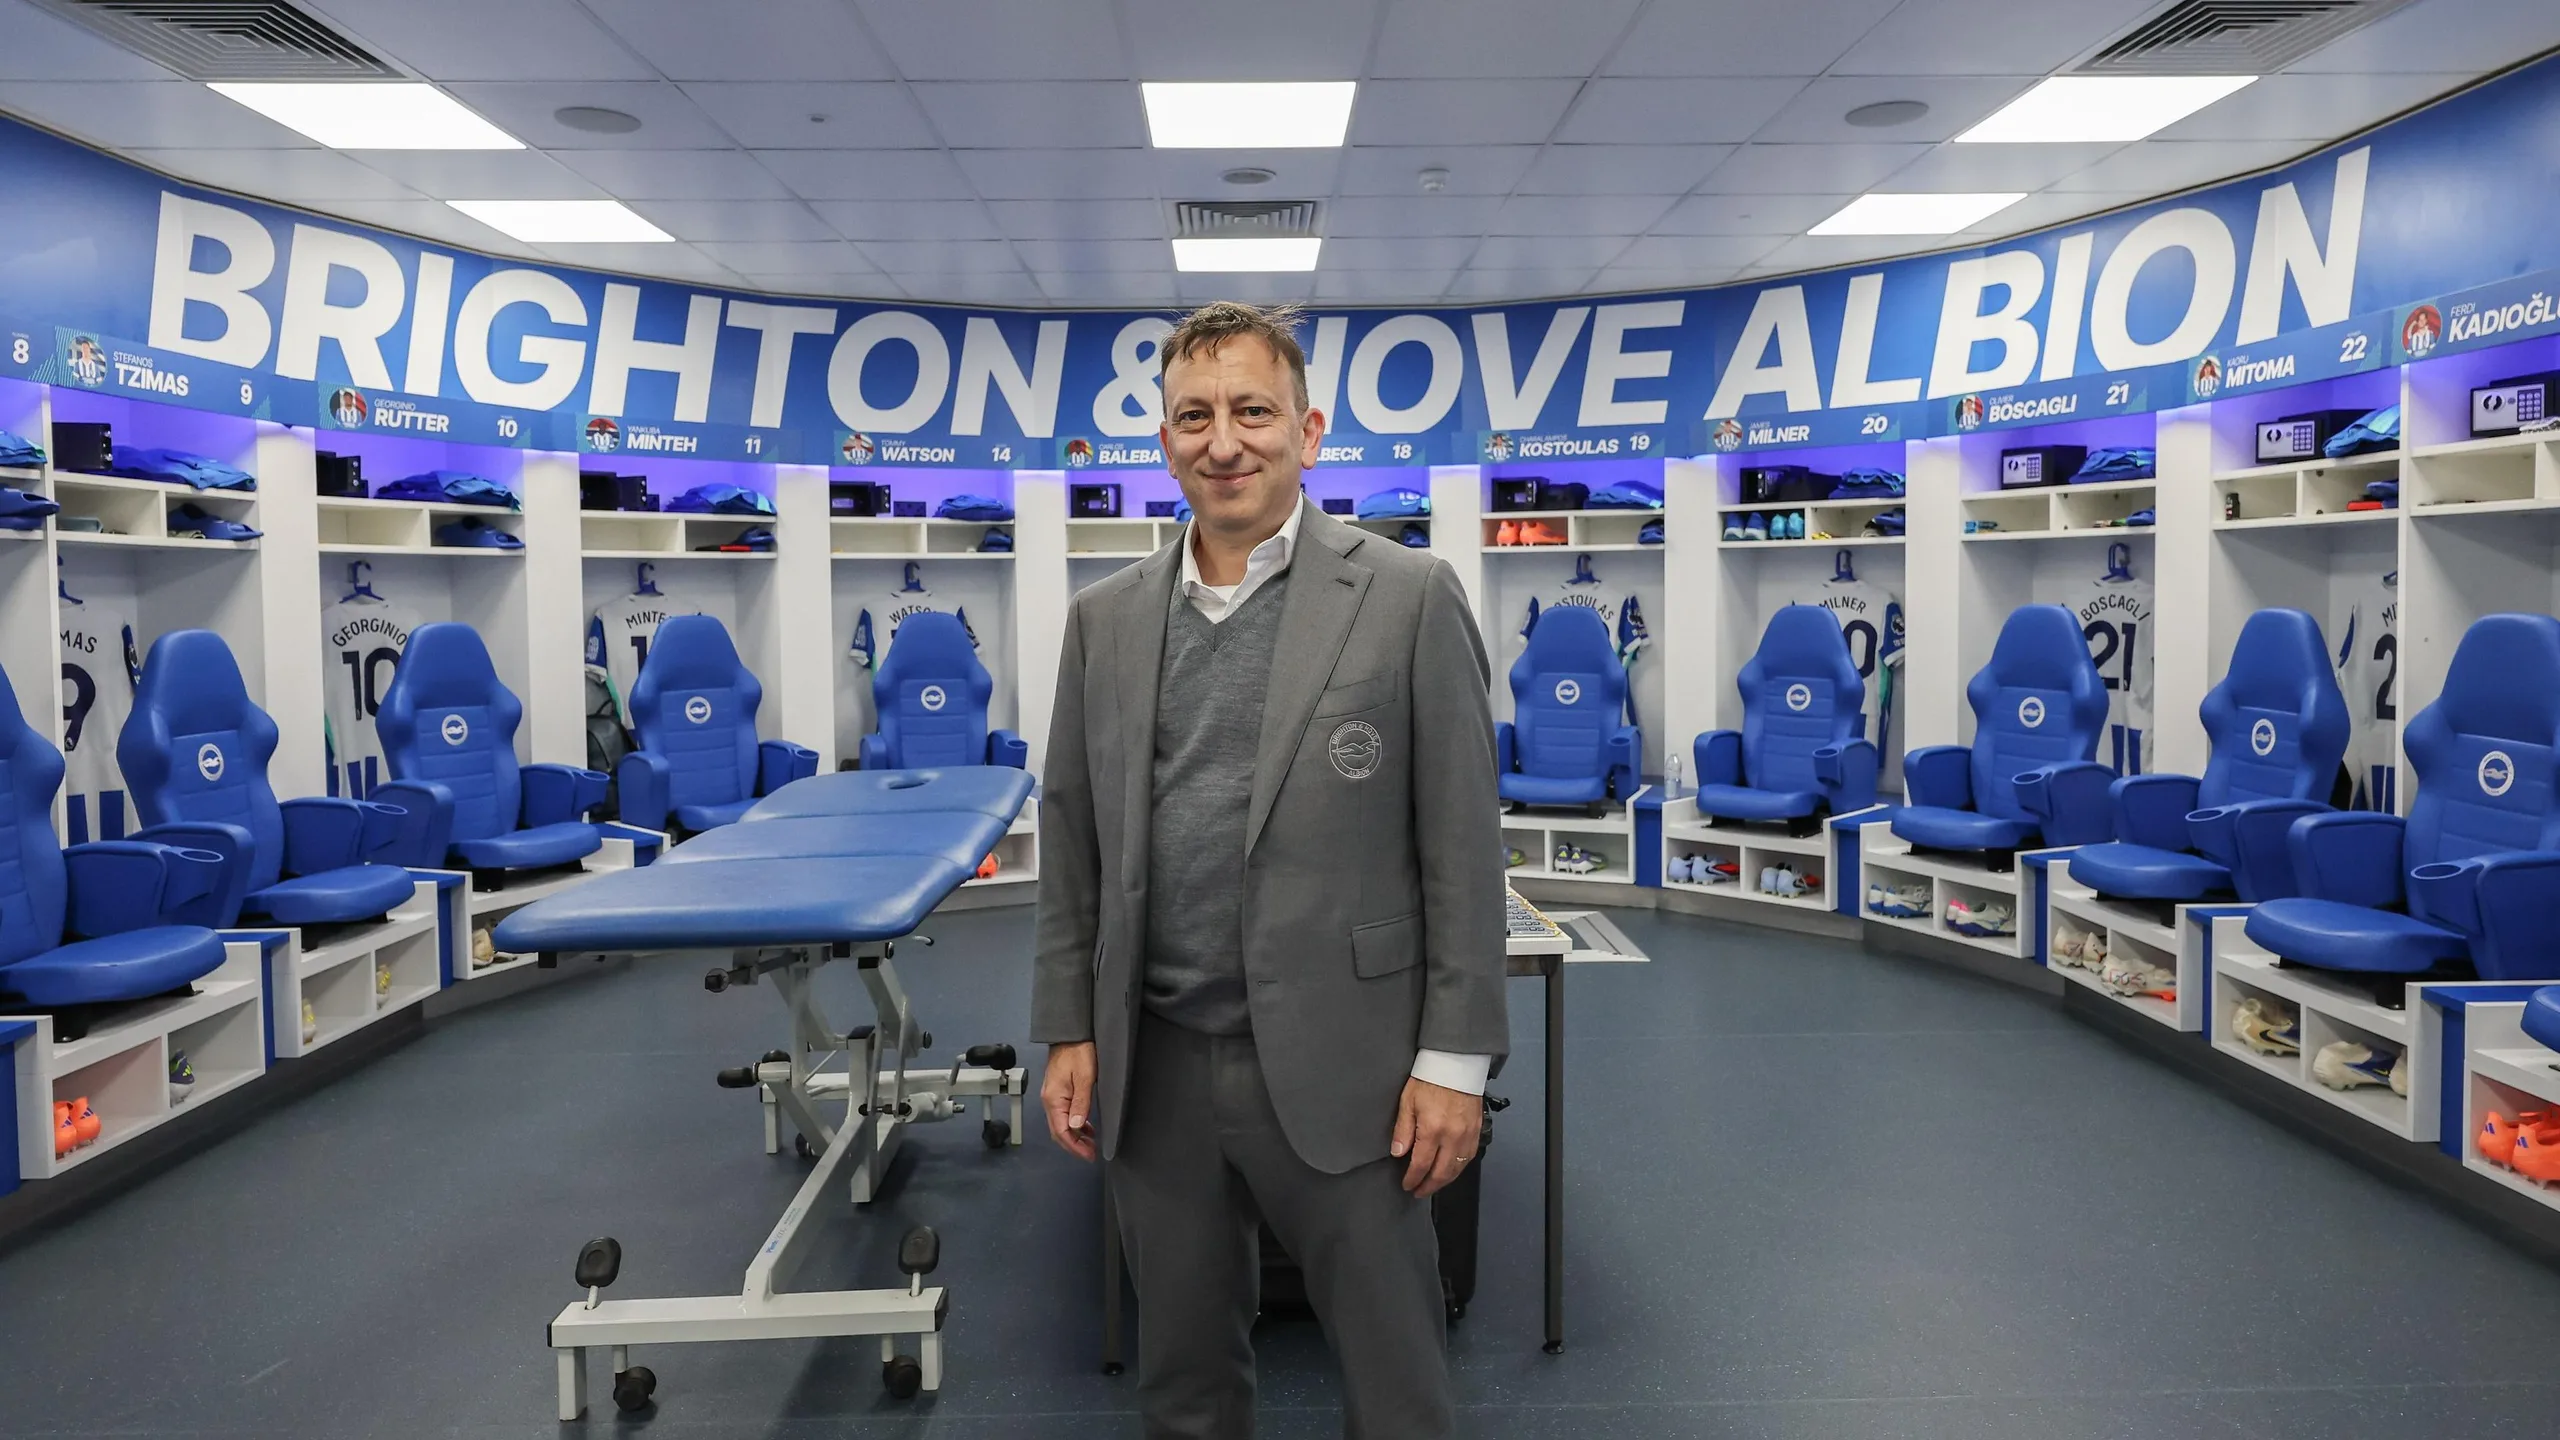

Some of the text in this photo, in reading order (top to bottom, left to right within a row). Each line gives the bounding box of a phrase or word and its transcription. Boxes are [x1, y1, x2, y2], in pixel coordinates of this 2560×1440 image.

[148, 190, 1069, 438] BRIGHTON
[1092, 317, 1167, 438] &
[1703, 145, 2370, 420] ALBION
[2448, 292, 2560, 343] KADIOĞL
[2450, 302, 2476, 317] FERDI
[13, 338, 29, 364] 8
[2339, 334, 2368, 363] 22
[113, 351, 153, 368] STEFANOS
[2226, 355, 2249, 367] KAORU
[115, 363, 189, 397] TZIMAS
[2225, 355, 2295, 388] MITOMA
[240, 384, 252, 405] 9
[374, 398, 416, 411] GEORGINIO
[2105, 383, 2129, 406] 21
[1988, 394, 2078, 423] BOSCAGLI
[374, 409, 450, 433] RUTTER
[497, 418, 518, 438] 10
[627, 425, 661, 434] YANKUBA
[1861, 416, 1888, 434] 20
[627, 433, 698, 453] MINTEH
[1629, 435, 1650, 451] 19
[1748, 425, 1810, 445] MILNER
[745, 438, 761, 454] 11
[881, 447, 955, 463] WATSON
[991, 447, 1011, 462] 14
[1316, 447, 1364, 461] BECK
[1392, 444, 1412, 459] 18
[1519, 438, 1619, 457] KOSTOULAS
[1098, 449, 1162, 464] BALEBA
[2080, 594, 2150, 622] BOSCAGLI
[625, 610, 672, 629] MINTE
[332, 618, 408, 647] GEORGINIO
[2083, 620, 2137, 692] 21
[1332, 723, 1357, 744] BRIGHTON
[1349, 768, 1370, 777] ALBION
